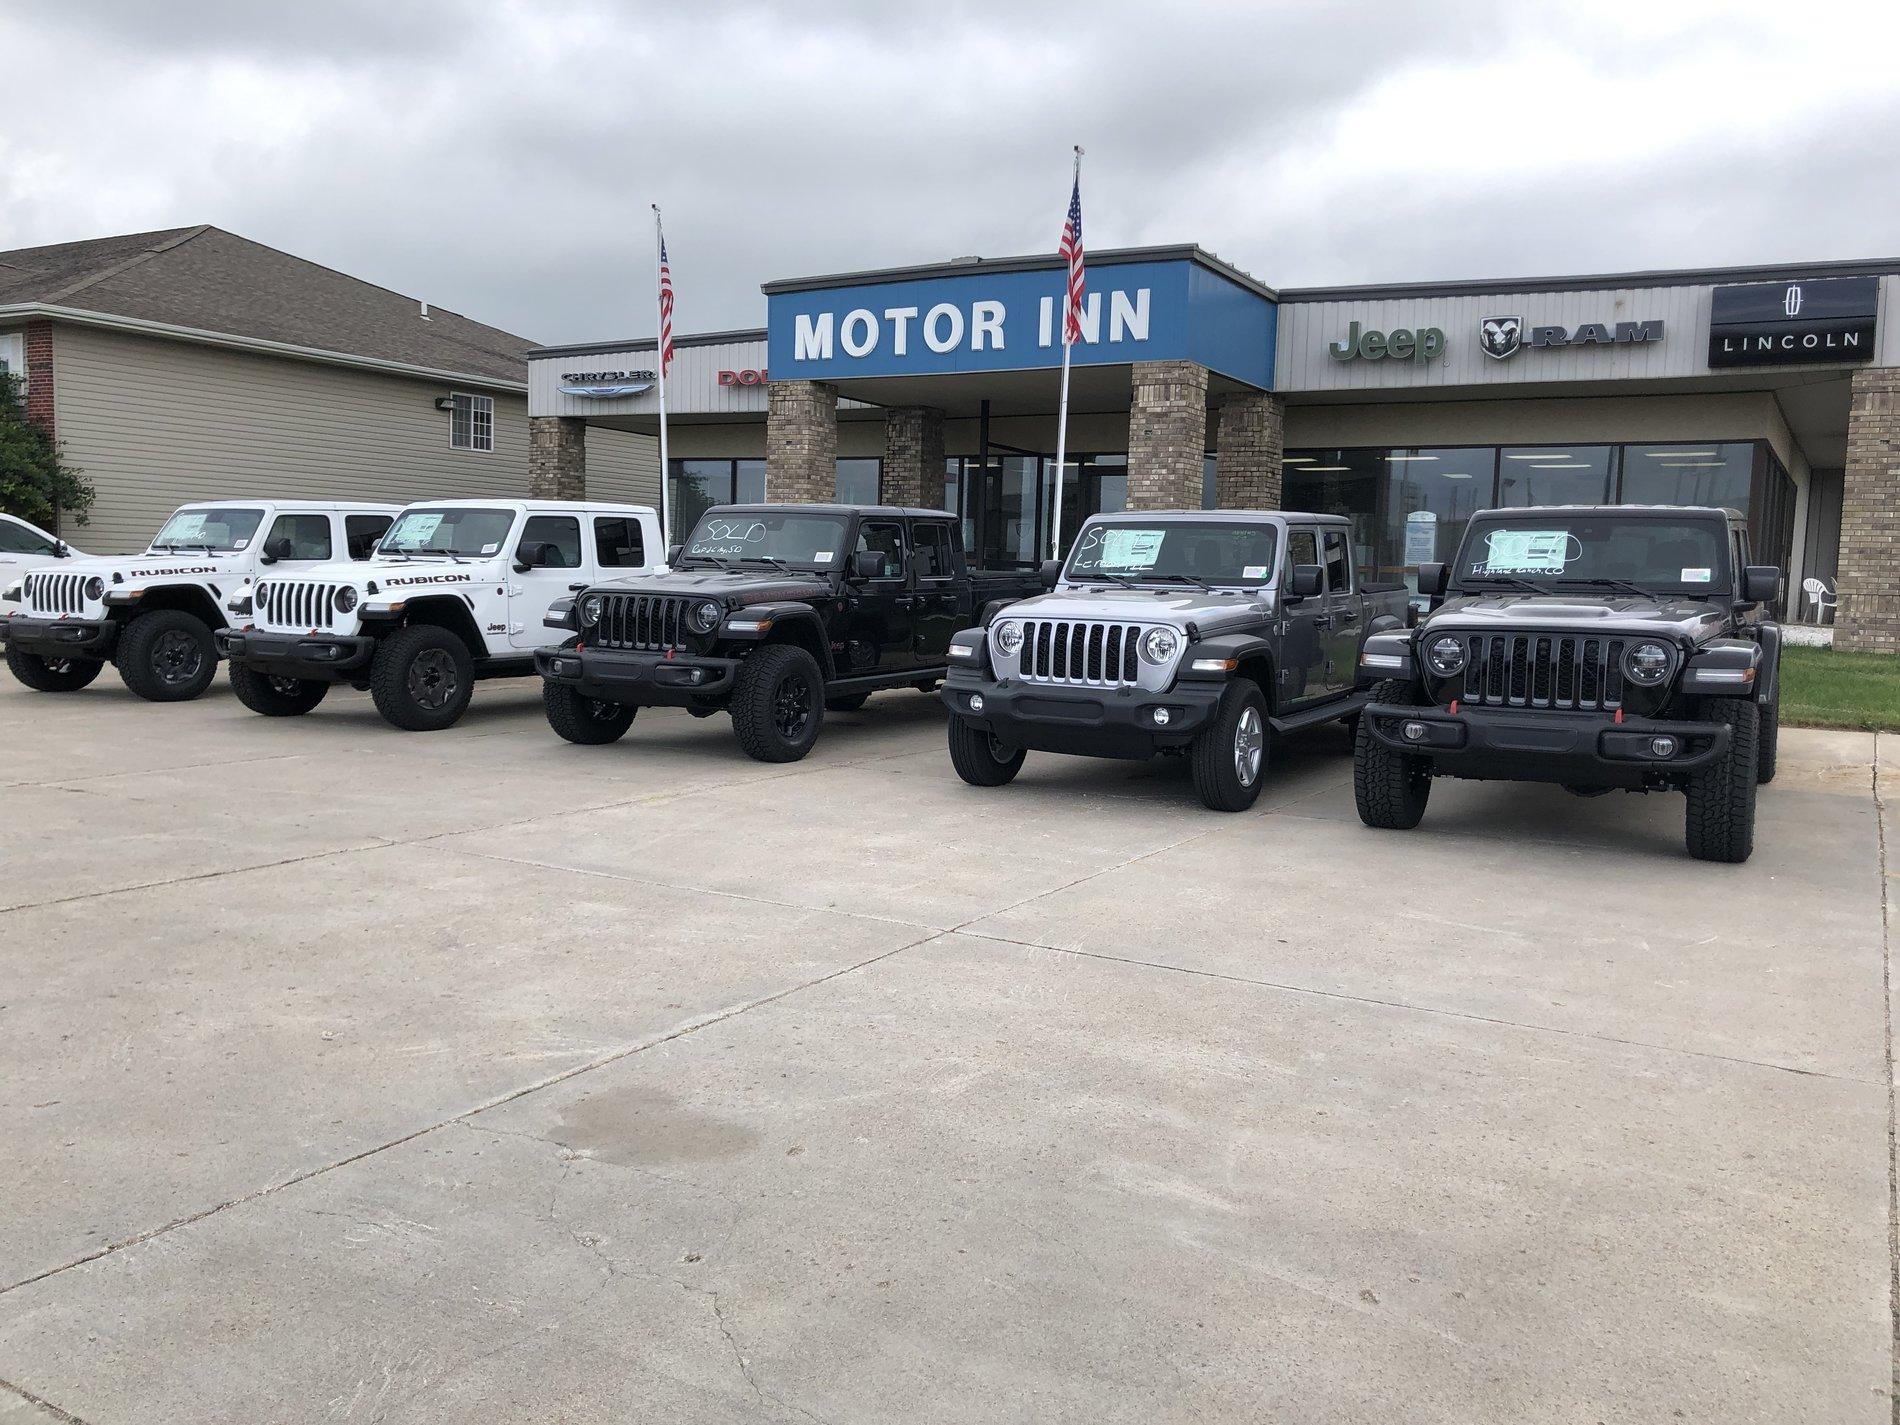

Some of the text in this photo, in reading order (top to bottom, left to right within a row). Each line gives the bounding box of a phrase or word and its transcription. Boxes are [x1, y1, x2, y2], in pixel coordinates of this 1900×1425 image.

[795, 288, 1151, 361] MOTOR INN
[1531, 319, 1665, 347] RAM
[1329, 320, 1446, 365] Jeep
[1724, 332, 1859, 352] LINCOLN
[561, 369, 653, 382] CHRYSLER
[698, 519, 767, 543] SOLD
[1471, 529, 1583, 566] SOLD
[131, 566, 217, 577] RUBICON
[385, 574, 471, 586] RUBICON
[487, 622, 507, 632] Jeep
